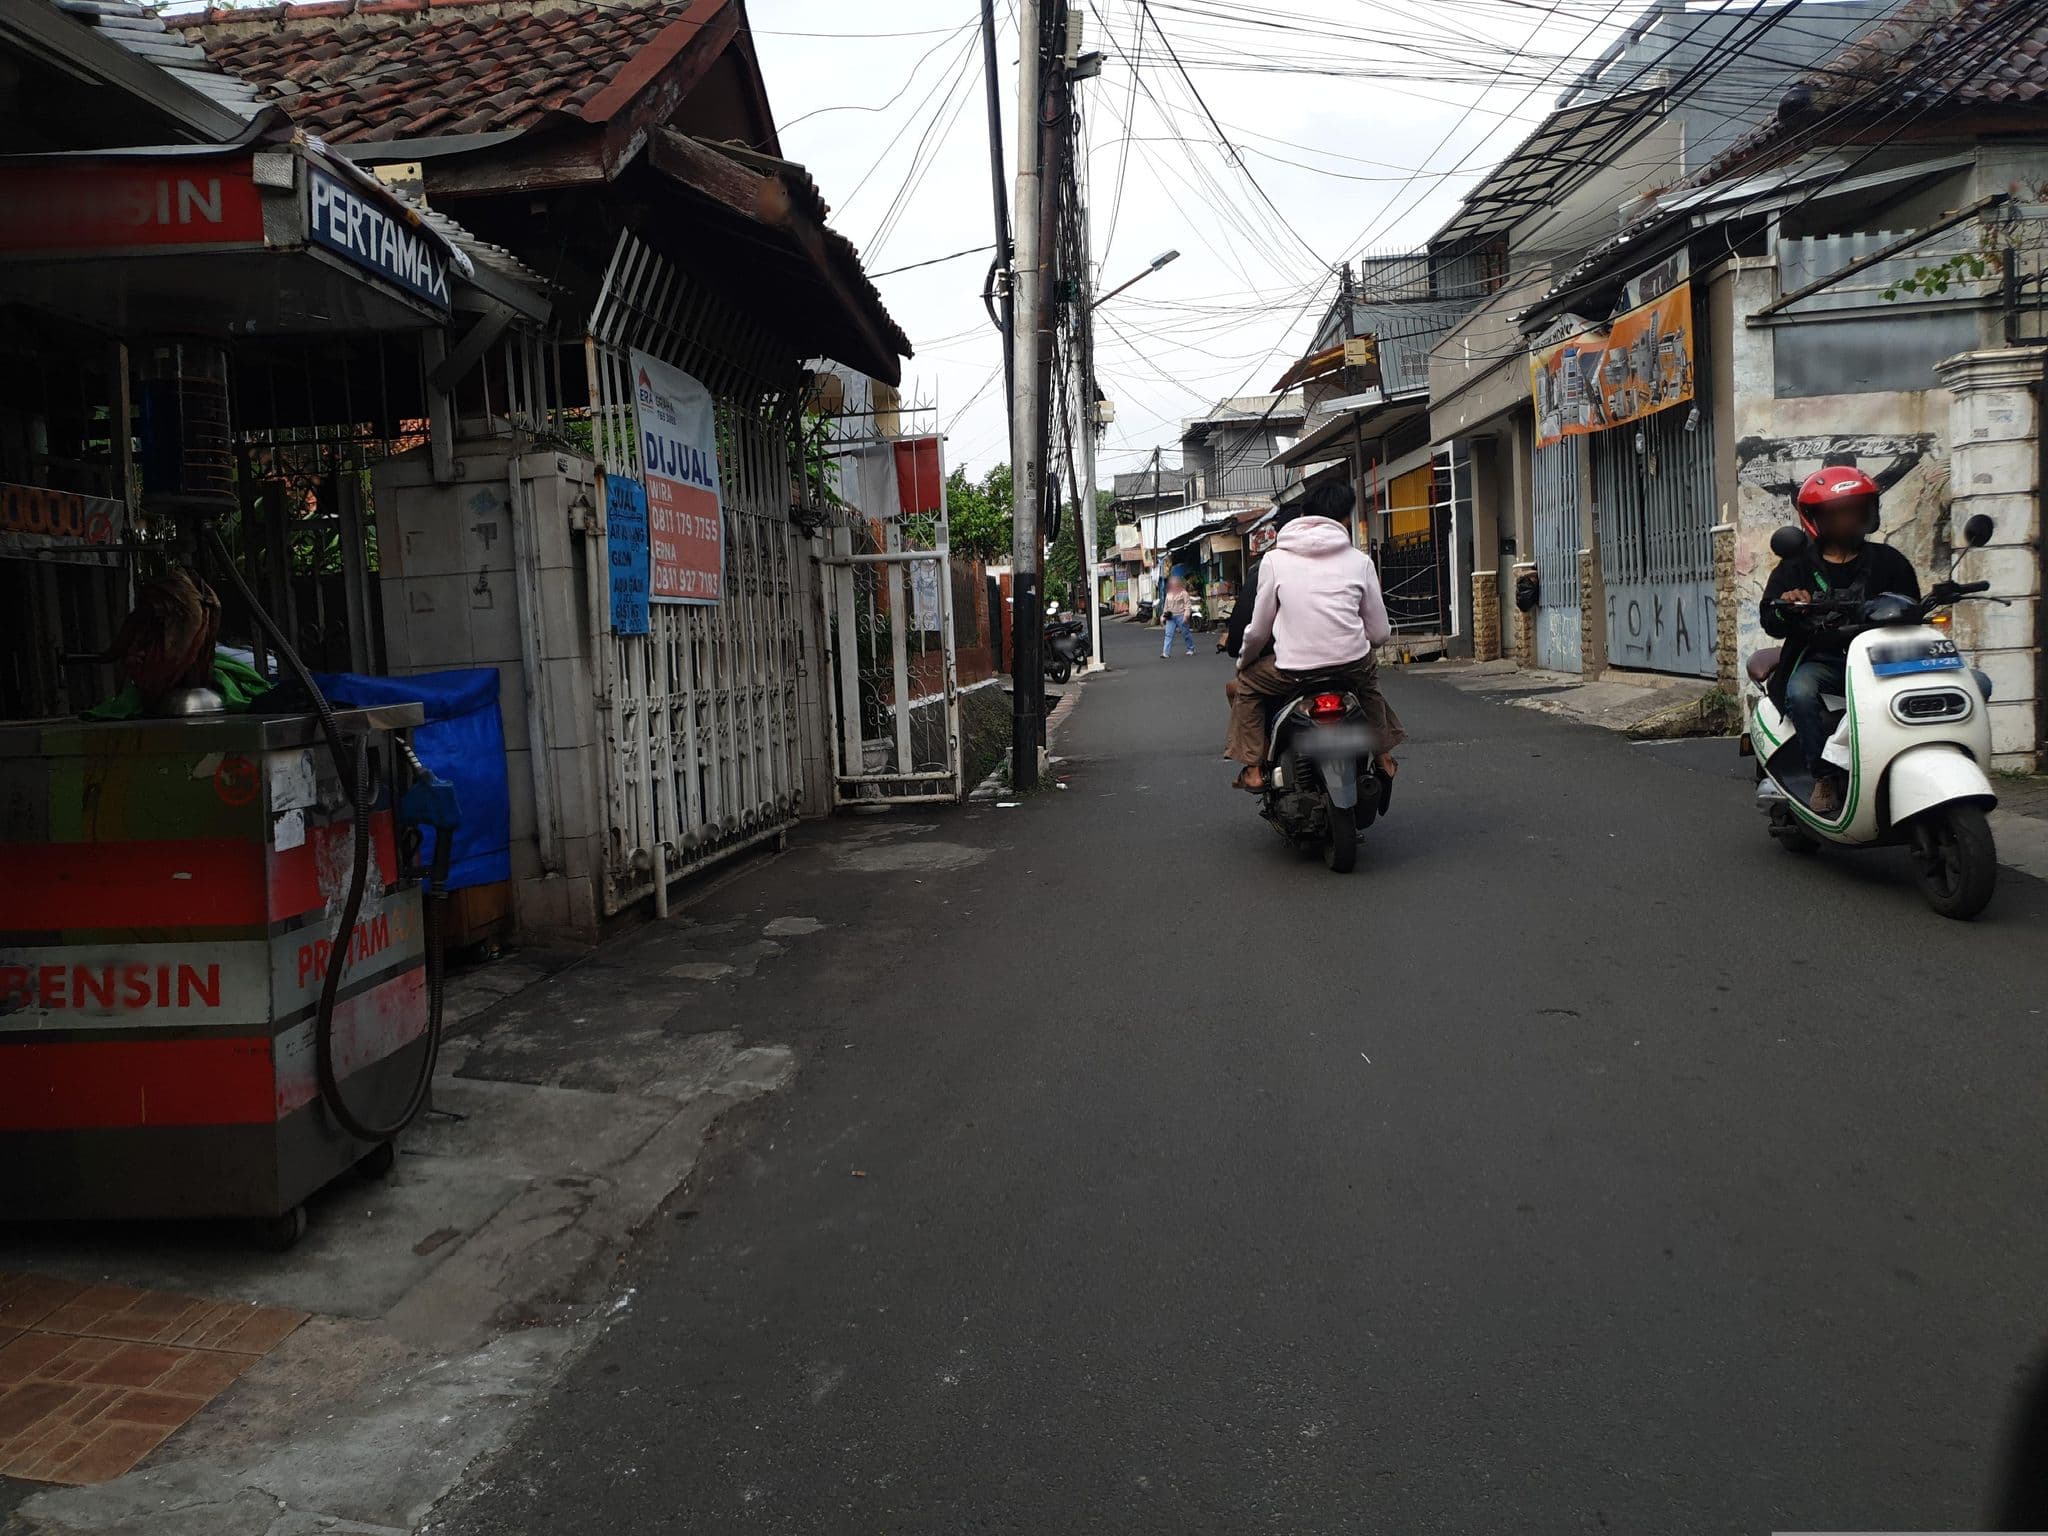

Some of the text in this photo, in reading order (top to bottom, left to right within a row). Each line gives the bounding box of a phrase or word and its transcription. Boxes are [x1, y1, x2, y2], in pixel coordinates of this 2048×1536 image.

[310, 172, 449, 304] PERTAMAX
[645, 431, 713, 487] DIJUAL
[649, 480, 673, 502] WIRA
[652, 505, 674, 533] 0811
[675, 511, 692, 537] 179
[694, 515, 718, 541] 7755
[655, 540, 677, 562] ERNA
[656, 565, 678, 590] 0811
[679, 568, 696, 592] 927
[0, 963, 220, 1009] BENSIN
